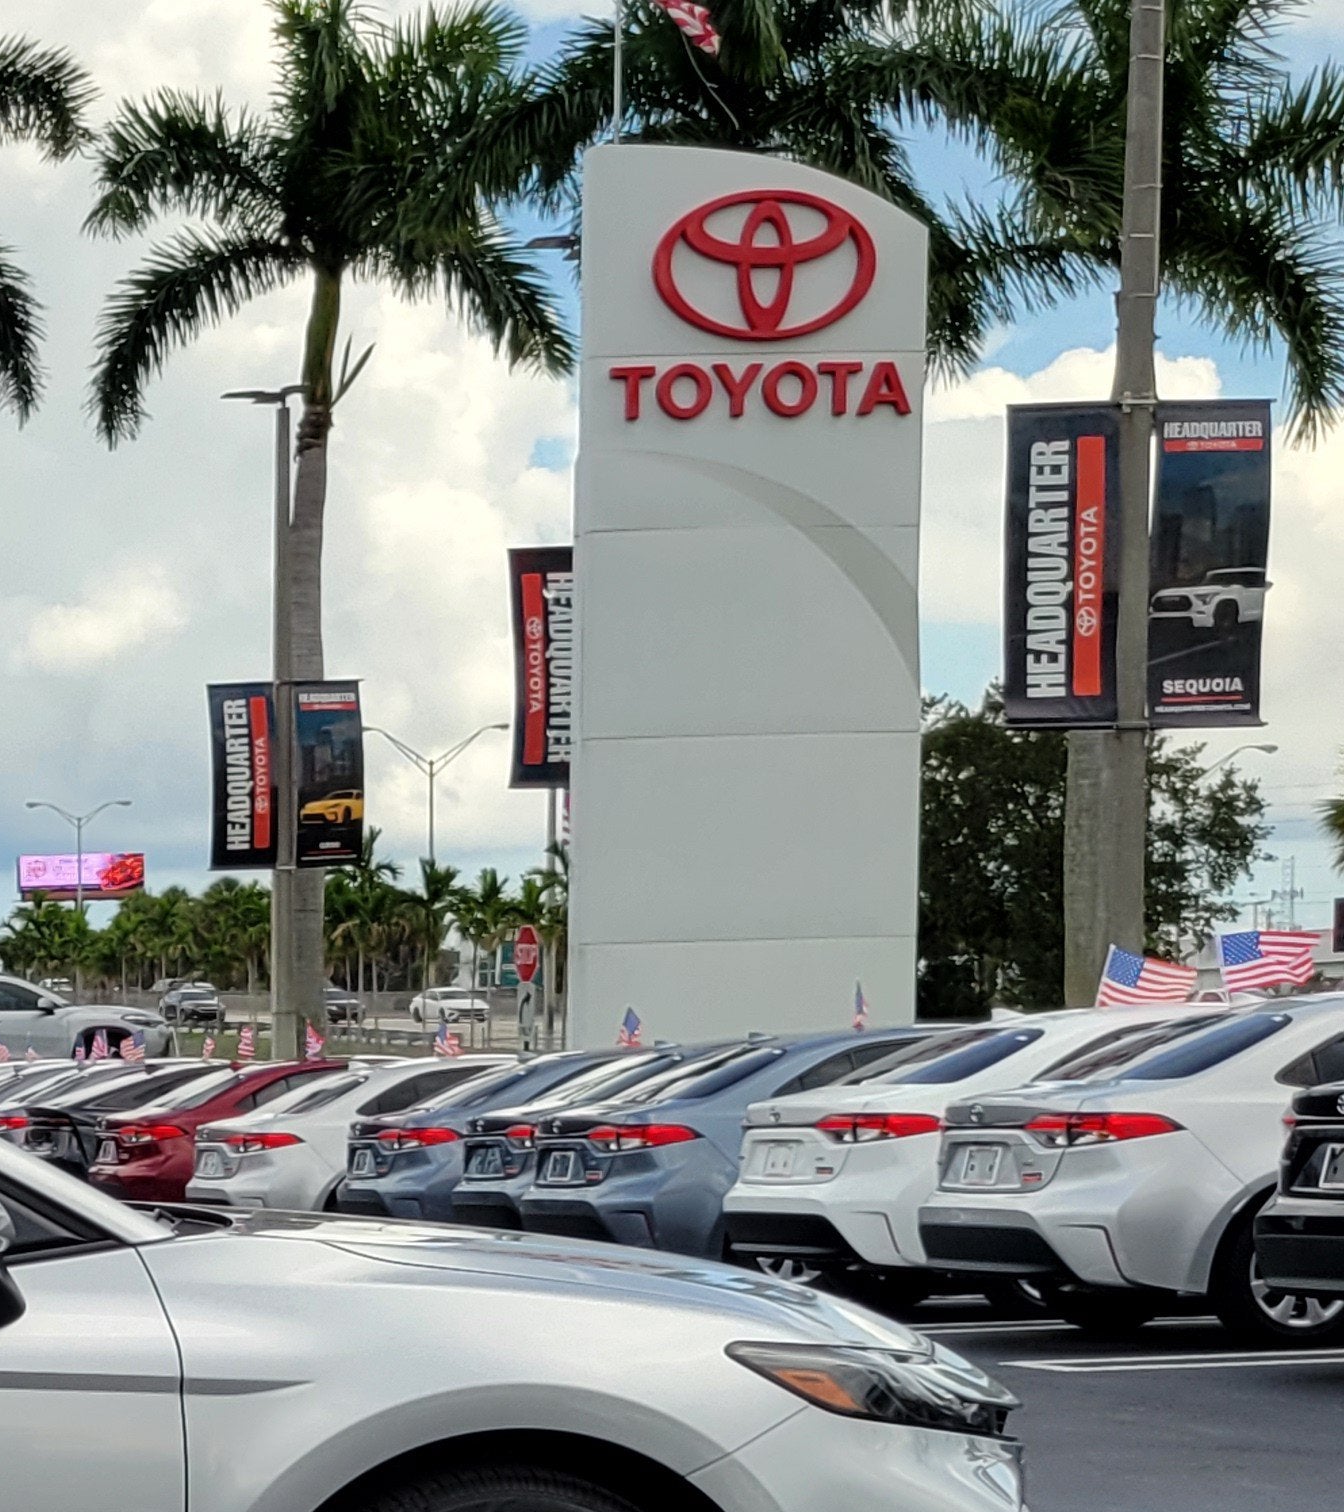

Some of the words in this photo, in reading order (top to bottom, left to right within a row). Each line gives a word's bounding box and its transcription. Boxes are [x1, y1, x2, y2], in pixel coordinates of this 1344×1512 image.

[609, 360, 912, 421] TOYOTA
[1163, 420, 1263, 440] HEADQUARTER
[1026, 439, 1073, 699] HEADQUARTER
[1078, 506, 1099, 604] TOYOTA
[529, 641, 543, 714] TOYOTA
[1161, 677, 1245, 695] SEQUOIA
[223, 699, 253, 850] HEADQUARTER
[254, 737, 268, 799] TOYOTA
